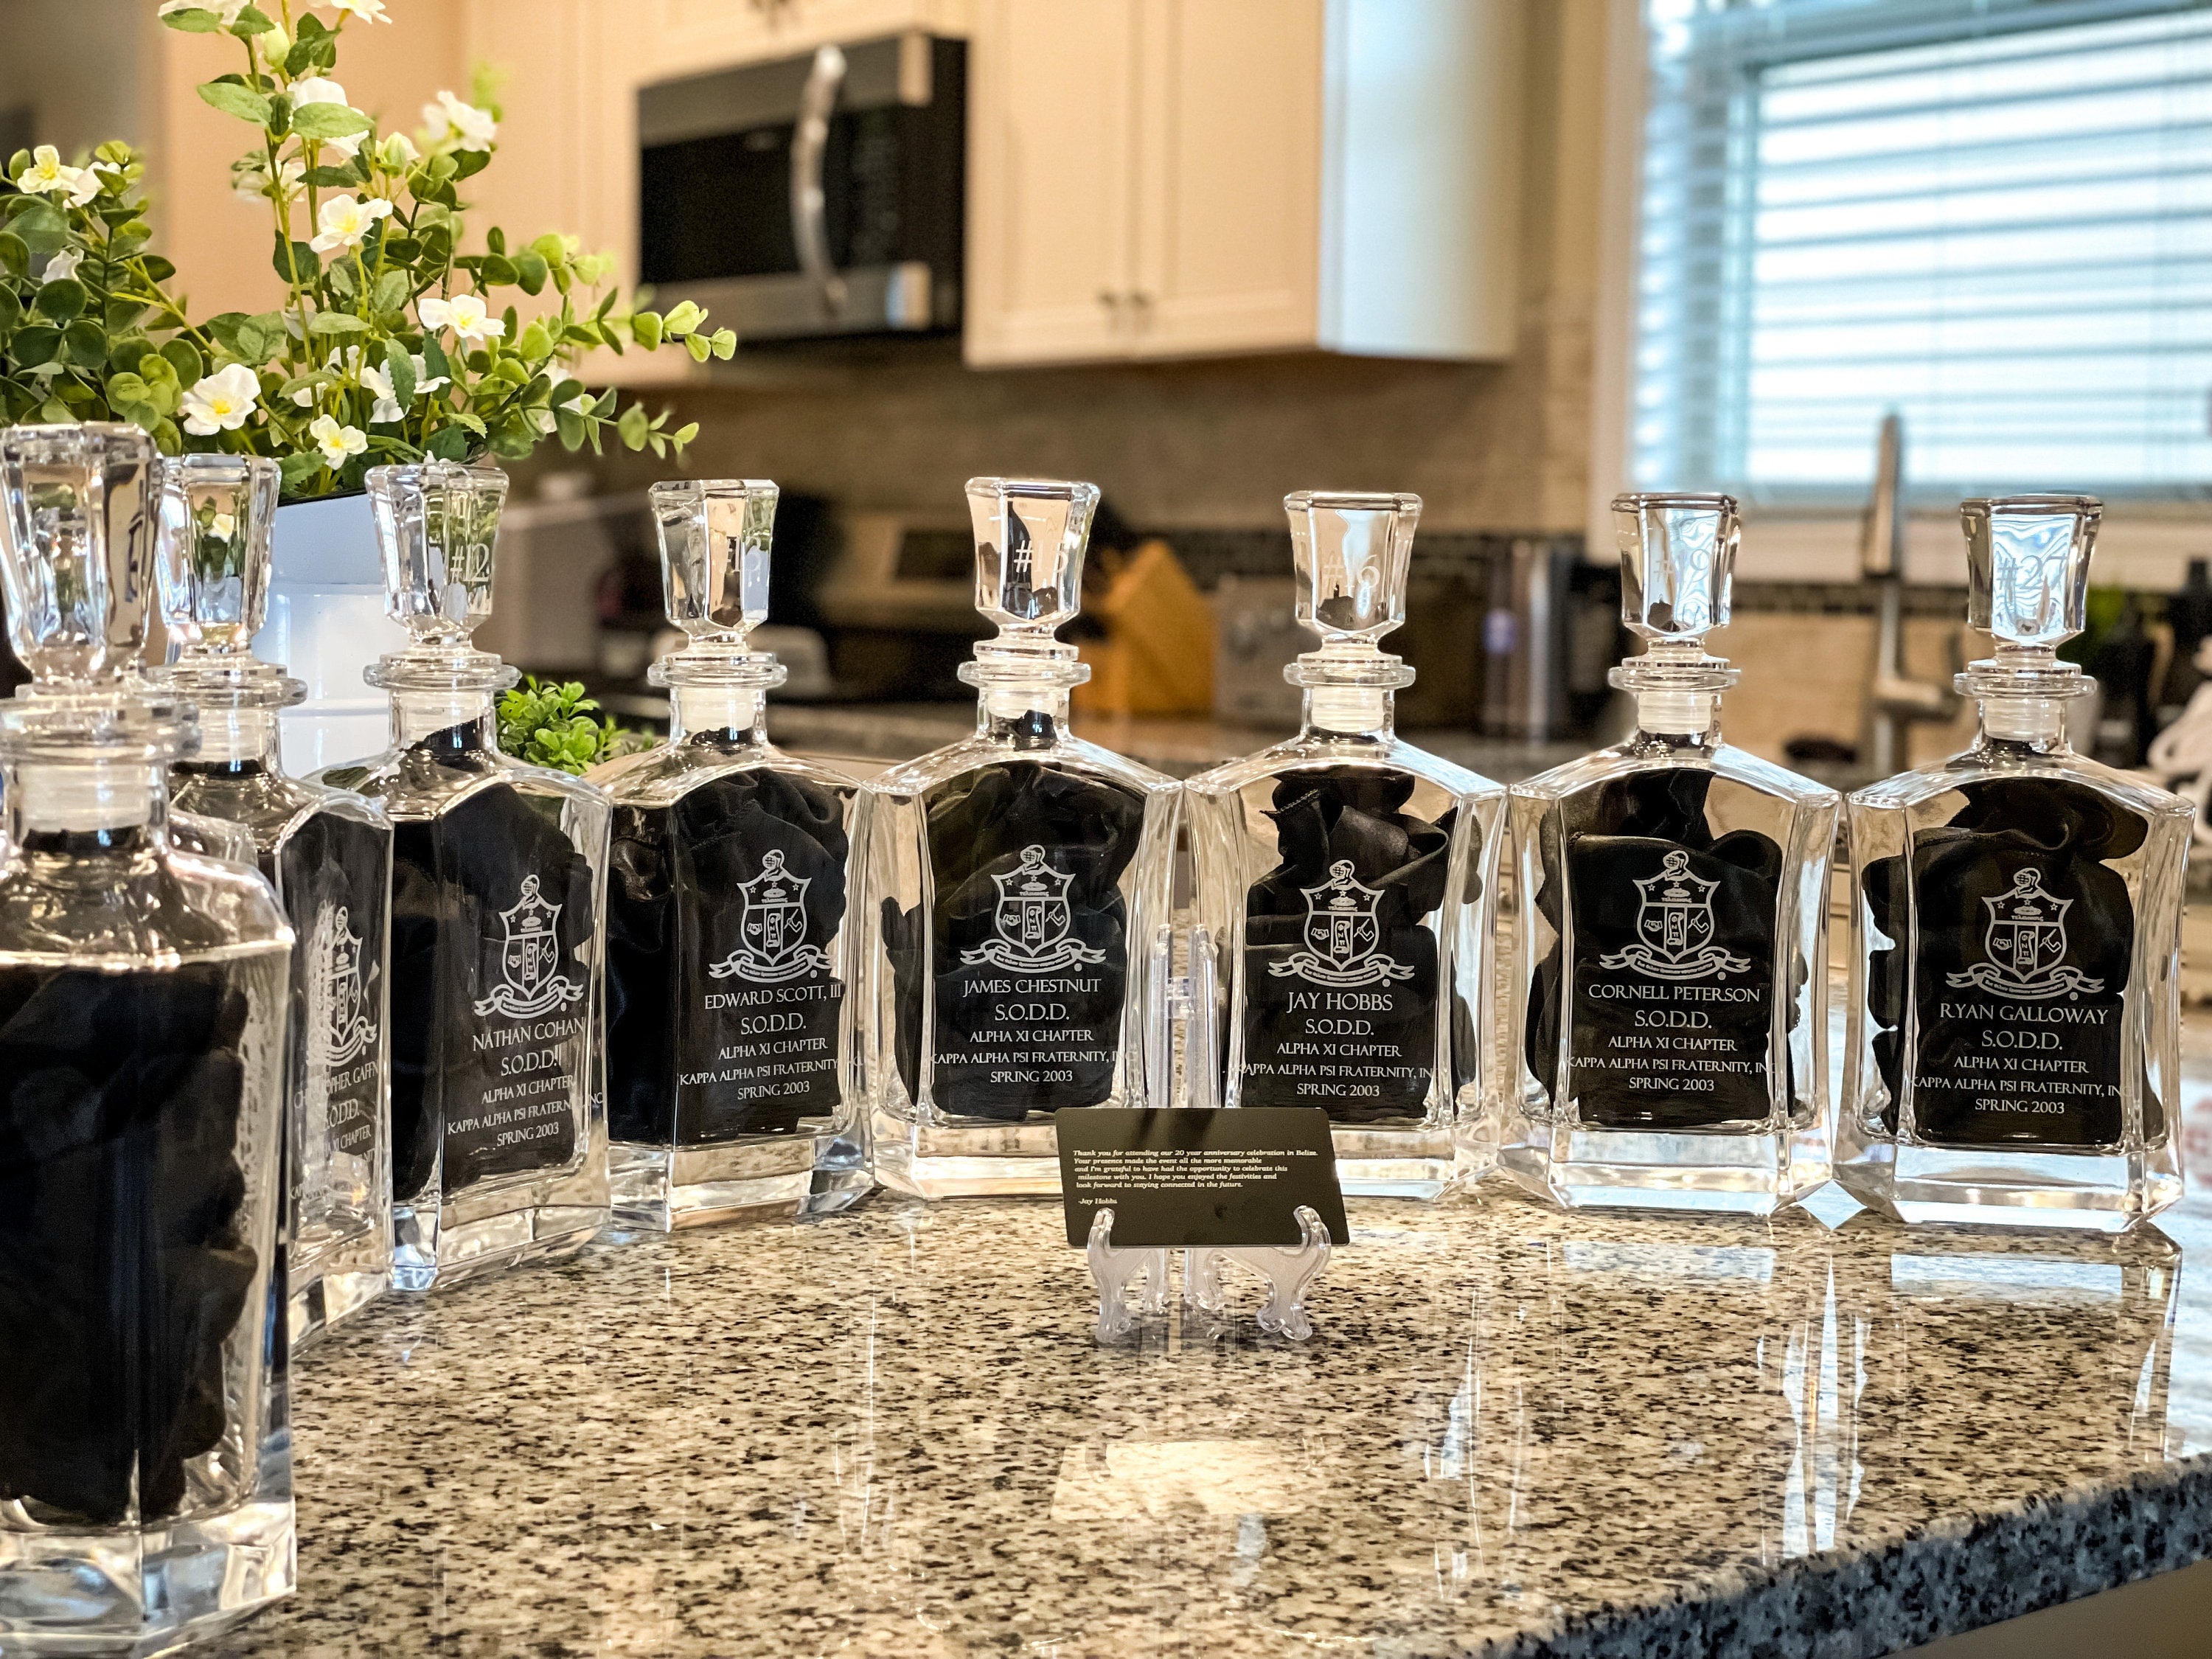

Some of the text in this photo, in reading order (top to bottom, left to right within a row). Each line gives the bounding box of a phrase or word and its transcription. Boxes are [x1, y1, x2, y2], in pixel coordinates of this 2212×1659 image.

[449, 543, 490, 582] #12
[1995, 554, 2067, 591] #27
[705, 984, 841, 1009] EDWARD SCOTT, III
[962, 978, 1102, 998] JAMES CHESTNUT
[1588, 984, 1761, 1002] CORNELL PETERSON
[995, 1003, 1070, 1021] S.O.D.D.
[1286, 992, 1393, 1013] JAY HOBBS
[740, 1012, 807, 1035] S.O.D.D.
[1635, 1010, 1713, 1029] S.O.D.D.
[1940, 1003, 2108, 1025] RYAN GALLOWAY
[472, 1016, 585, 1051] NATHAN COHAN
[970, 1029, 1095, 1043] ALPHA XI CHAPTER
[1305, 1019, 1374, 1036] S.O.D.D.
[718, 1037, 829, 1060] ALPHA XI CHAPTER
[1276, 1043, 1402, 1057] ALPHA XI CHAPTER
[1608, 1036, 1738, 1051] ALPHA XI CHAPTER
[1981, 1029, 2063, 1051] S.O.D.D.
[501, 1049, 557, 1077] S.O.D.D.
[970, 1052, 1009, 1064] ALPHA
[1013, 1051, 1029, 1063] PSI
[1032, 1051, 1110, 1064] FRATERNITY,
[1608, 1057, 1649, 1070] ALPHA
[1652, 1059, 1669, 1071] PSI
[1672, 1060, 1753, 1075] FRATERNITY,
[1954, 1056, 2090, 1074] ALPHA XI CHAPTER
[680, 1071, 717, 1085] KAPPA
[719, 1068, 754, 1082] ALPHA
[757, 1065, 771, 1077] PSI
[990, 1070, 1074, 1083] SPRING 2003
[1277, 1064, 1317, 1076] ALPHA
[1319, 1065, 1335, 1077] PSI
[1339, 1066, 1417, 1079] FRATERNITY,
[481, 1075, 577, 1105] ALPHA XI CHAPTER
[737, 1080, 810, 1100] SPRING 2003
[1296, 1084, 1380, 1097] SPRING 2003
[1629, 1077, 1714, 1091] SPRING 2003
[1954, 1078, 1997, 1092] ALPHA
[2000, 1079, 2017, 1092] PSI
[2020, 1080, 2104, 1098] FRATERNITY,
[1975, 1099, 2065, 1114] SPRING 2003
[448, 1118, 481, 1135] KAPPA
[482, 1111, 512, 1128] ALPHA
[514, 1108, 526, 1121] PSI
[529, 1099, 573, 1119] FRATERN
[340, 1124, 372, 1150] CHAPTER
[497, 1121, 560, 1147] SPRING 2003
